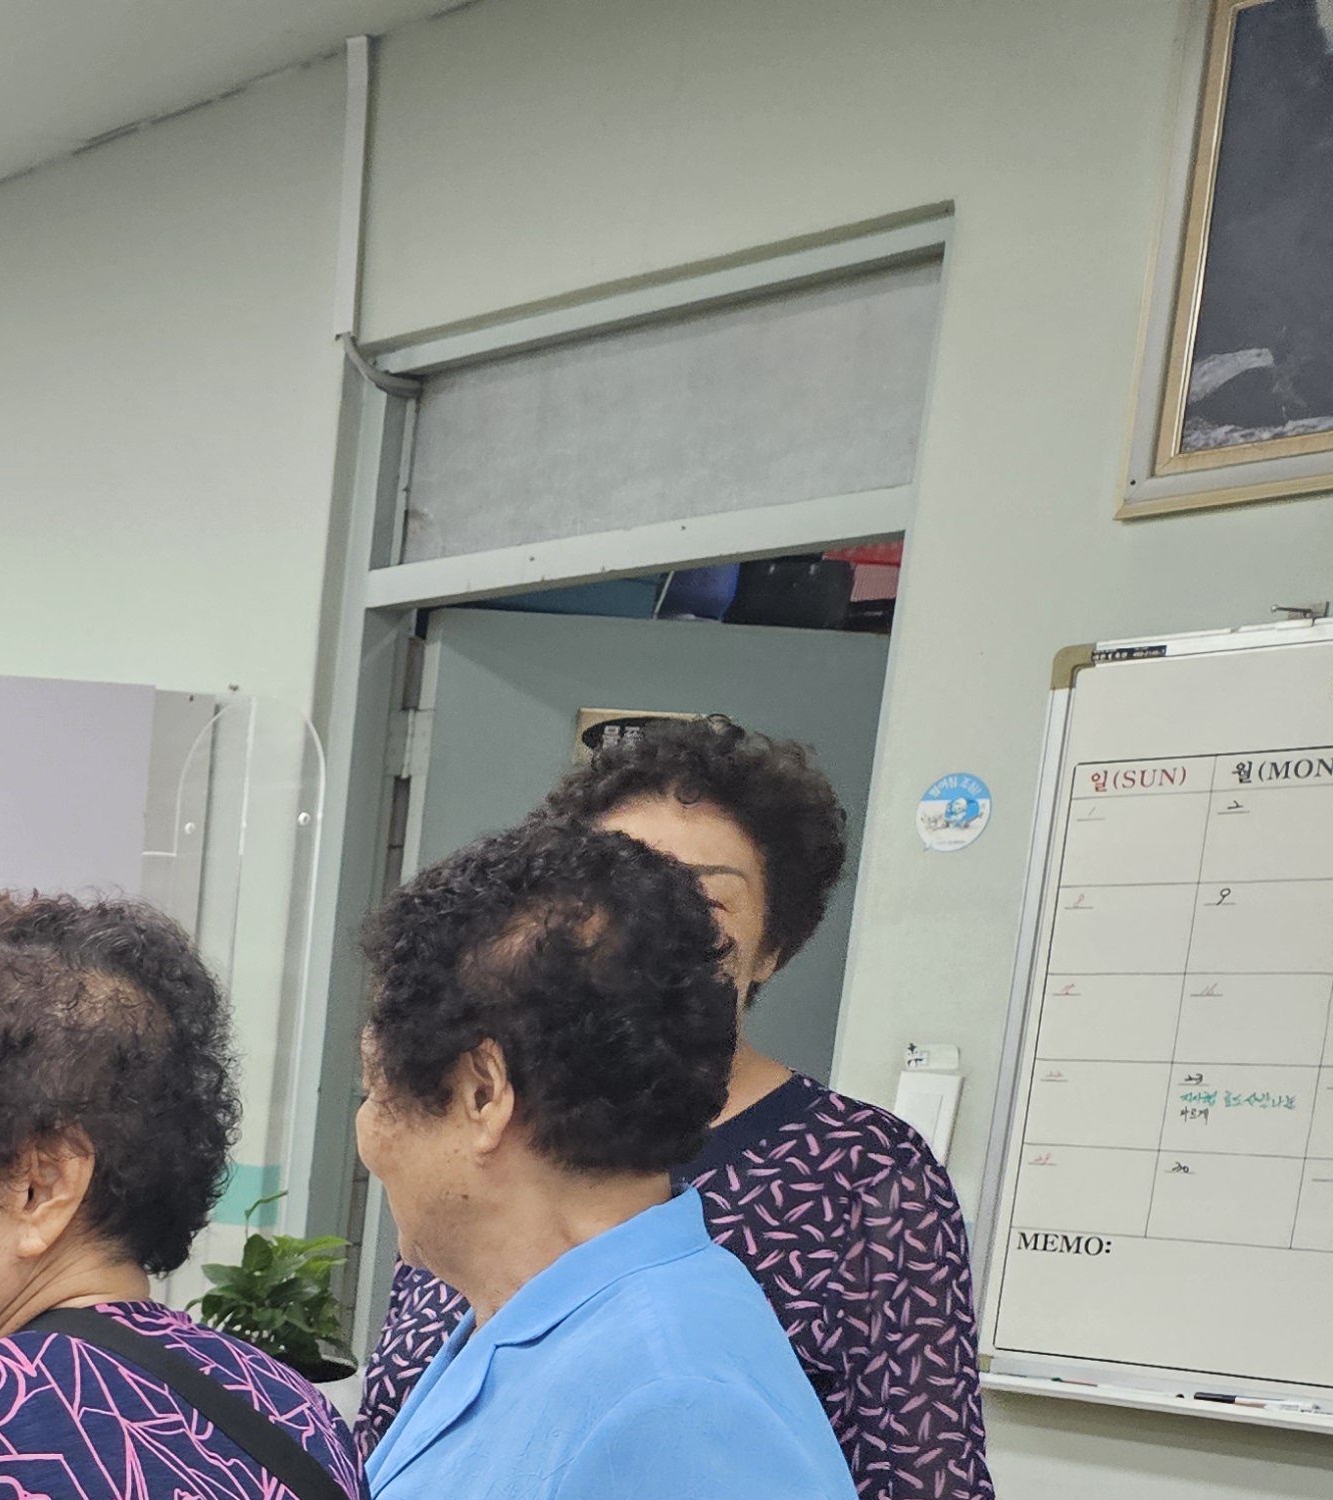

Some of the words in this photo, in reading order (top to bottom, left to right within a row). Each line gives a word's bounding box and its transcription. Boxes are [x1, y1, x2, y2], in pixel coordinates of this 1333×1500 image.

[1091, 766, 1187, 792] 일(SUN)
[1216, 888, 1231, 906] 9
[1184, 1073, 1203, 1085] 23
[1171, 1161, 1189, 1173] 30
[1017, 1231, 1111, 1256] MEMO:
